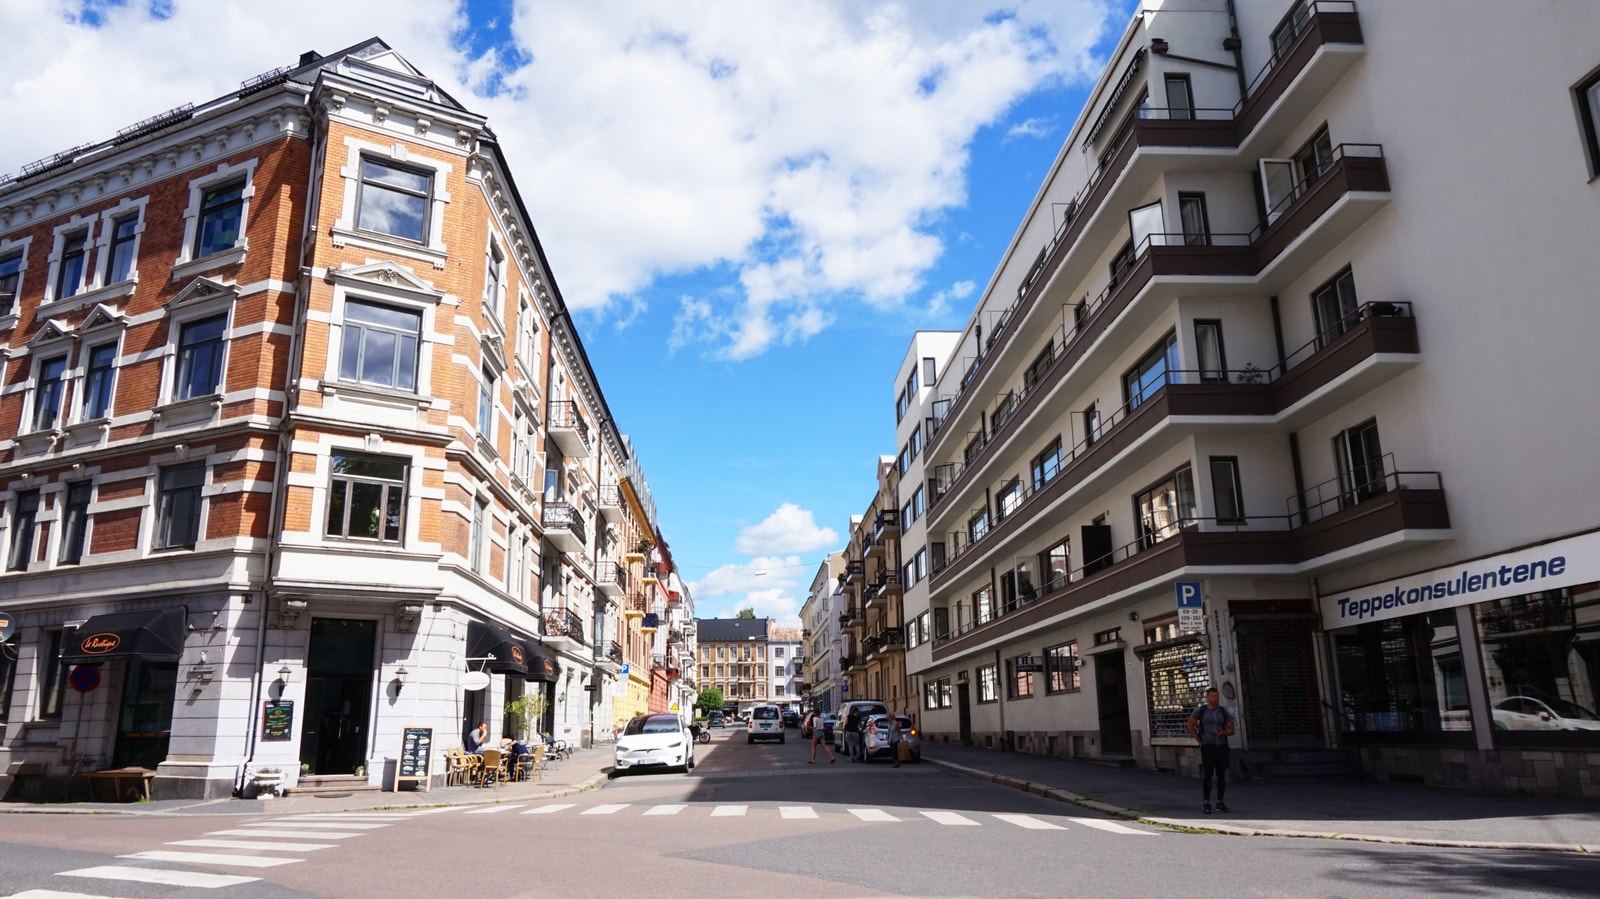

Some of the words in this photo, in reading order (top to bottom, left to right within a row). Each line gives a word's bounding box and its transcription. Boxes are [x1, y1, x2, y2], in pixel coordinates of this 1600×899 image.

[1182, 585, 1195, 605] P
[1338, 556, 1566, 619] Teppekonsulentene
[621, 665, 628, 673] P
